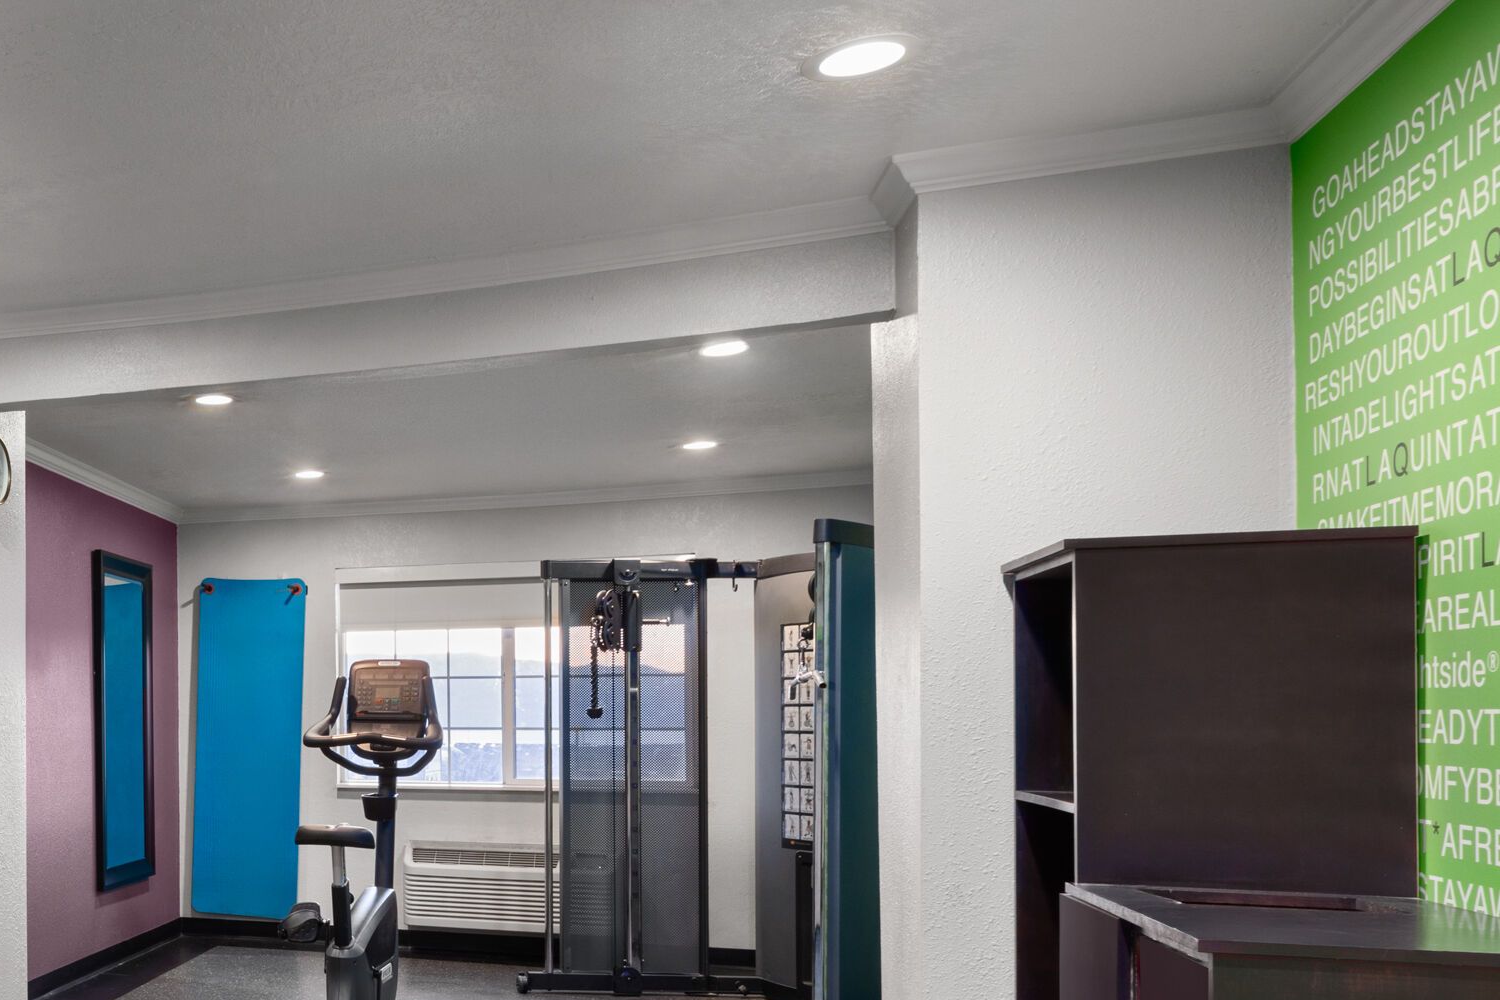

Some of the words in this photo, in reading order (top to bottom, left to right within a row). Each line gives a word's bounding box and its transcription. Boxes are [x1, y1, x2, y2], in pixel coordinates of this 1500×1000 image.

[1305, 289, 1499, 413] RESHYOUROUTLO
[1313, 345, 1500, 456] INTADELIGHTSAT
[1313, 406, 1500, 504] RNATLAQUINTAT
[1415, 589, 1500, 634] AREAL
